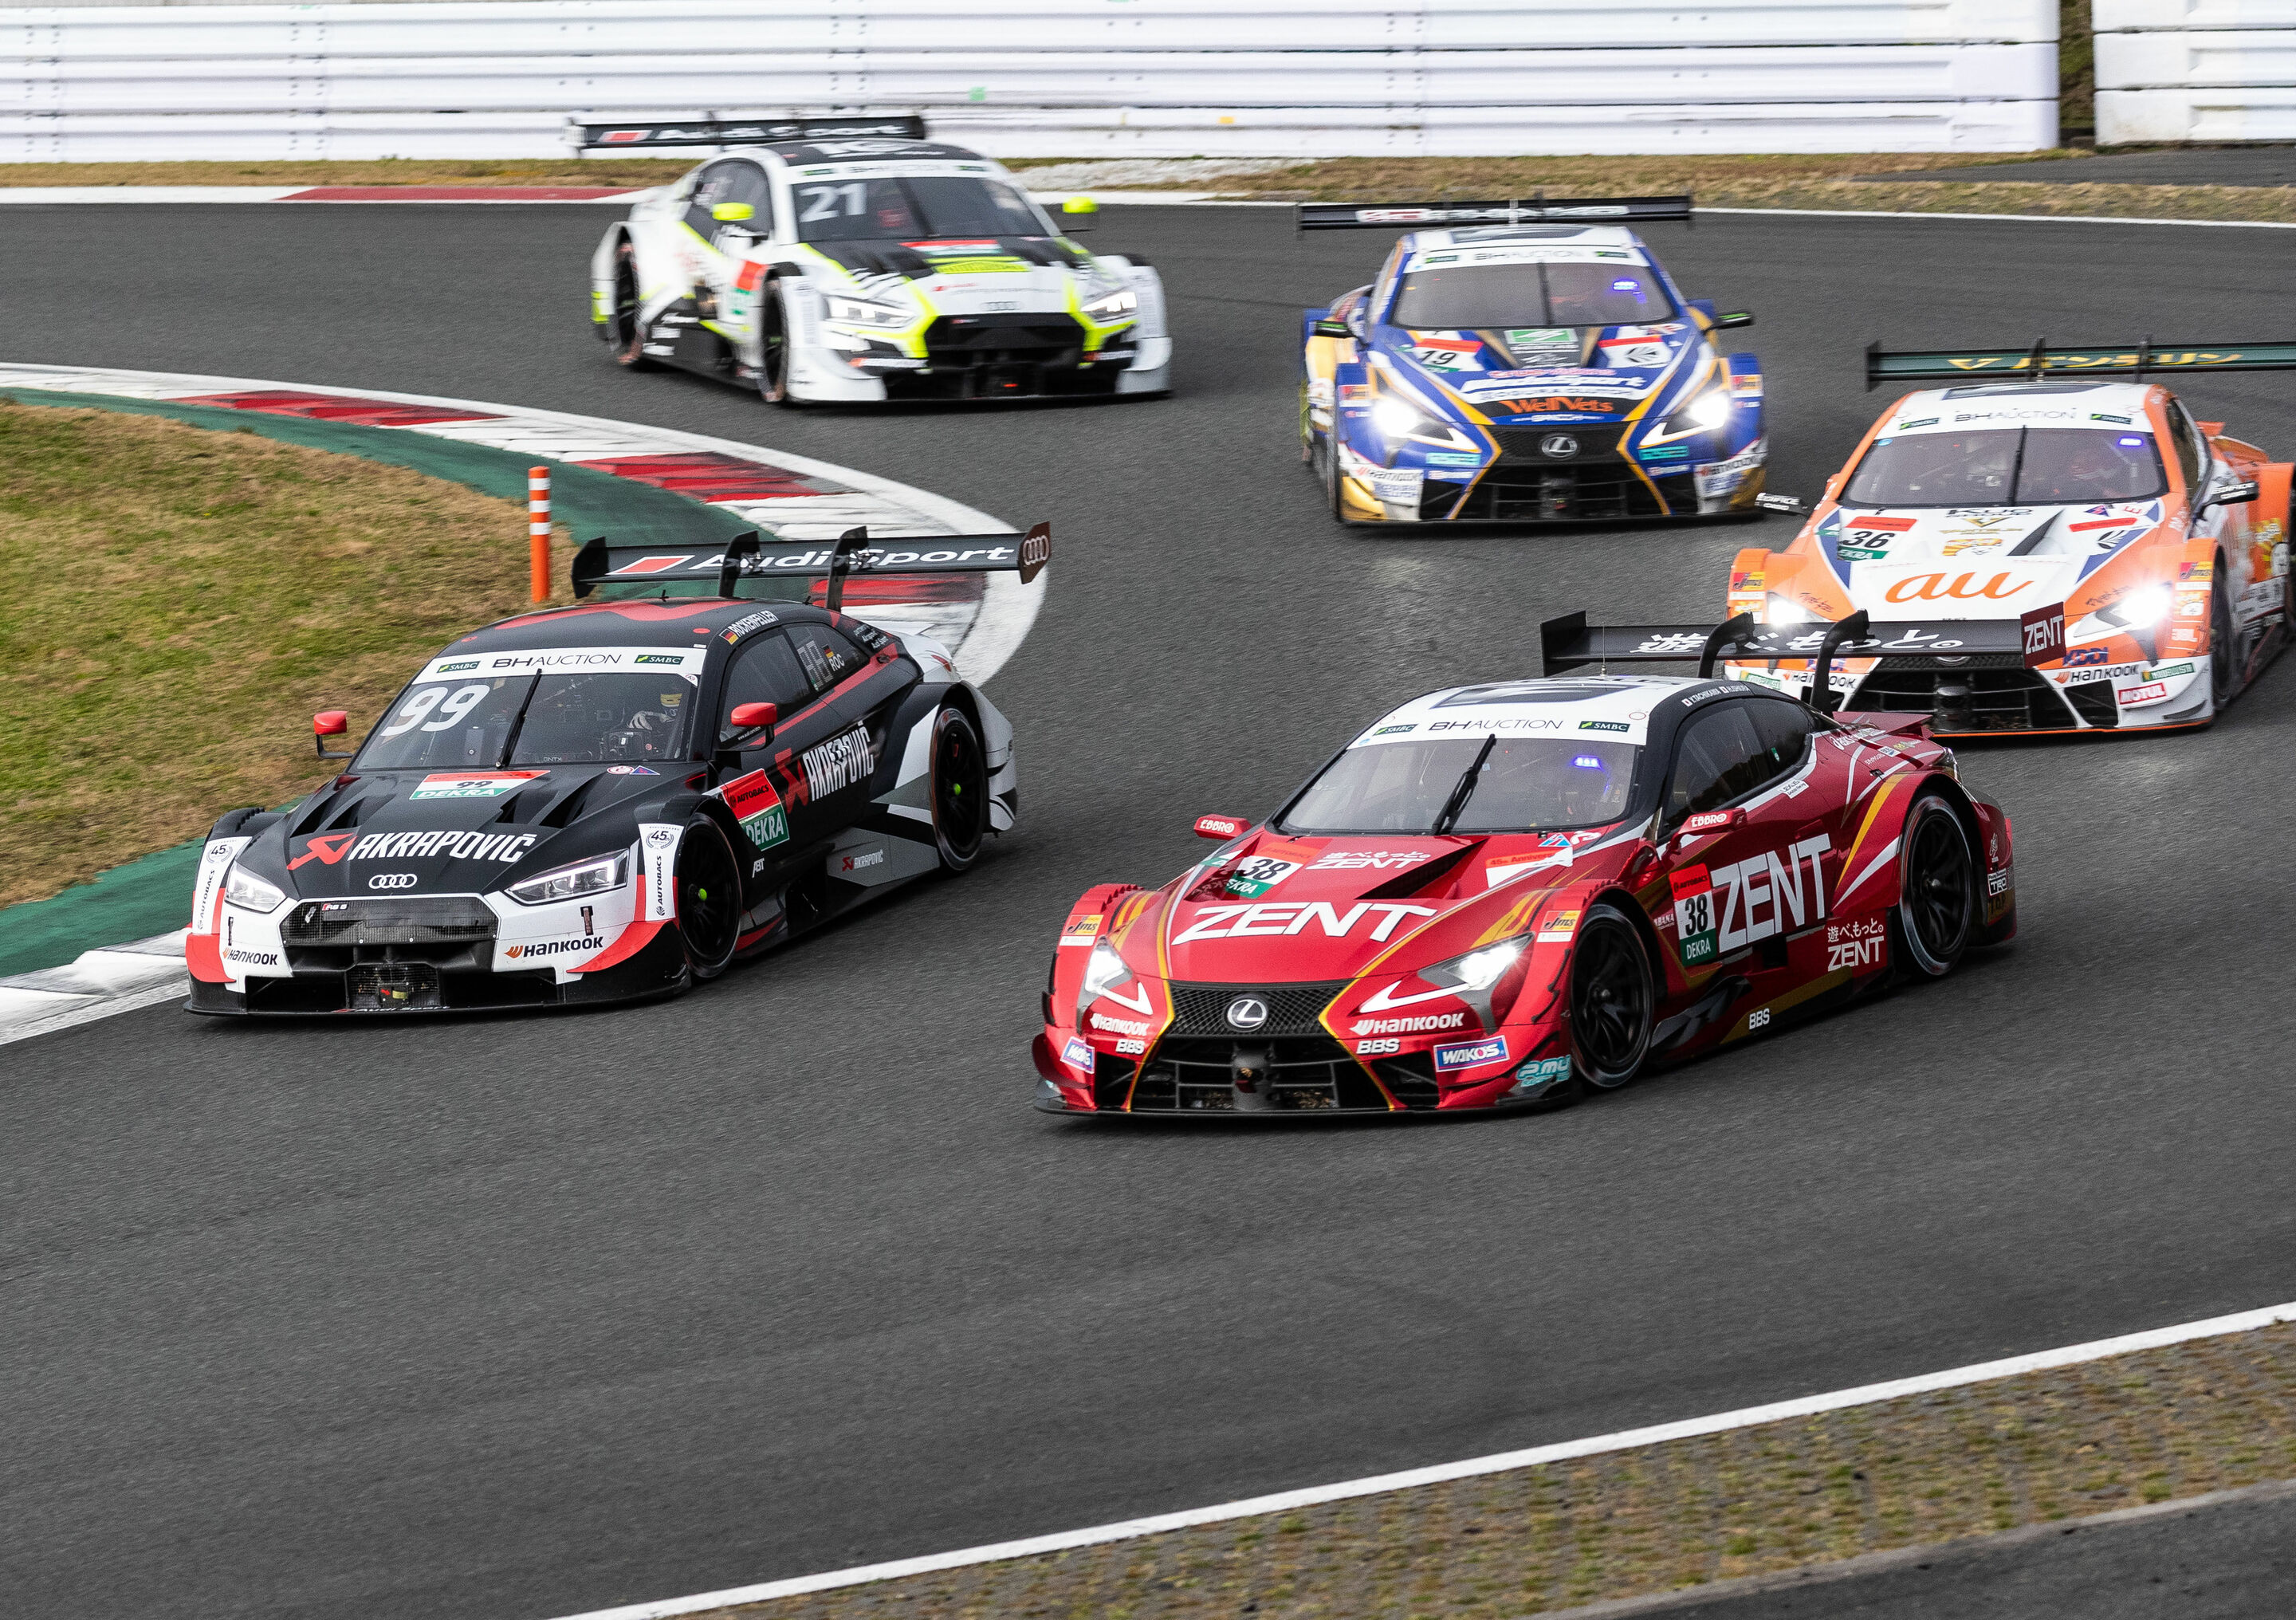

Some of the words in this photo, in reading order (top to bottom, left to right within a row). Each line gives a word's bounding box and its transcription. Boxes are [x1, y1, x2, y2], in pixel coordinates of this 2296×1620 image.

[800, 183, 867, 223] 21
[1421, 350, 1457, 365] 19
[1842, 531, 1896, 549] 36
[1885, 572, 2035, 603] au
[2024, 615, 2064, 655] ZENT
[648, 655, 682, 665] SMBC
[828, 654, 845, 671] ROC
[2062, 647, 2109, 666] KDDI
[449, 663, 478, 671] SMBC
[2119, 686, 2164, 703] MOTUL
[380, 684, 490, 737] 99
[1593, 722, 1629, 731] SMBC
[417, 788, 496, 798] DEKRA
[737, 784, 769, 803] AUTOBACS
[745, 812, 784, 846] DEKRA
[1199, 819, 1235, 834] EBBRO
[1691, 812, 1728, 828] EBBRO
[347, 831, 538, 863] AKRAPOVIČ
[752, 858, 765, 879] ABT
[1244, 859, 1292, 880] 38
[1304, 858, 1427, 871] ZENT
[1710, 832, 1831, 954] ZENT
[1170, 901, 1438, 946] ZENT
[1685, 894, 1708, 937] 38
[1686, 937, 1712, 960] DEKRA
[1827, 935, 1885, 973] ZENT
[1748, 1008, 1770, 1030] BBS
[1116, 1038, 1146, 1055] BBS
[1355, 1038, 1401, 1055] BBS
